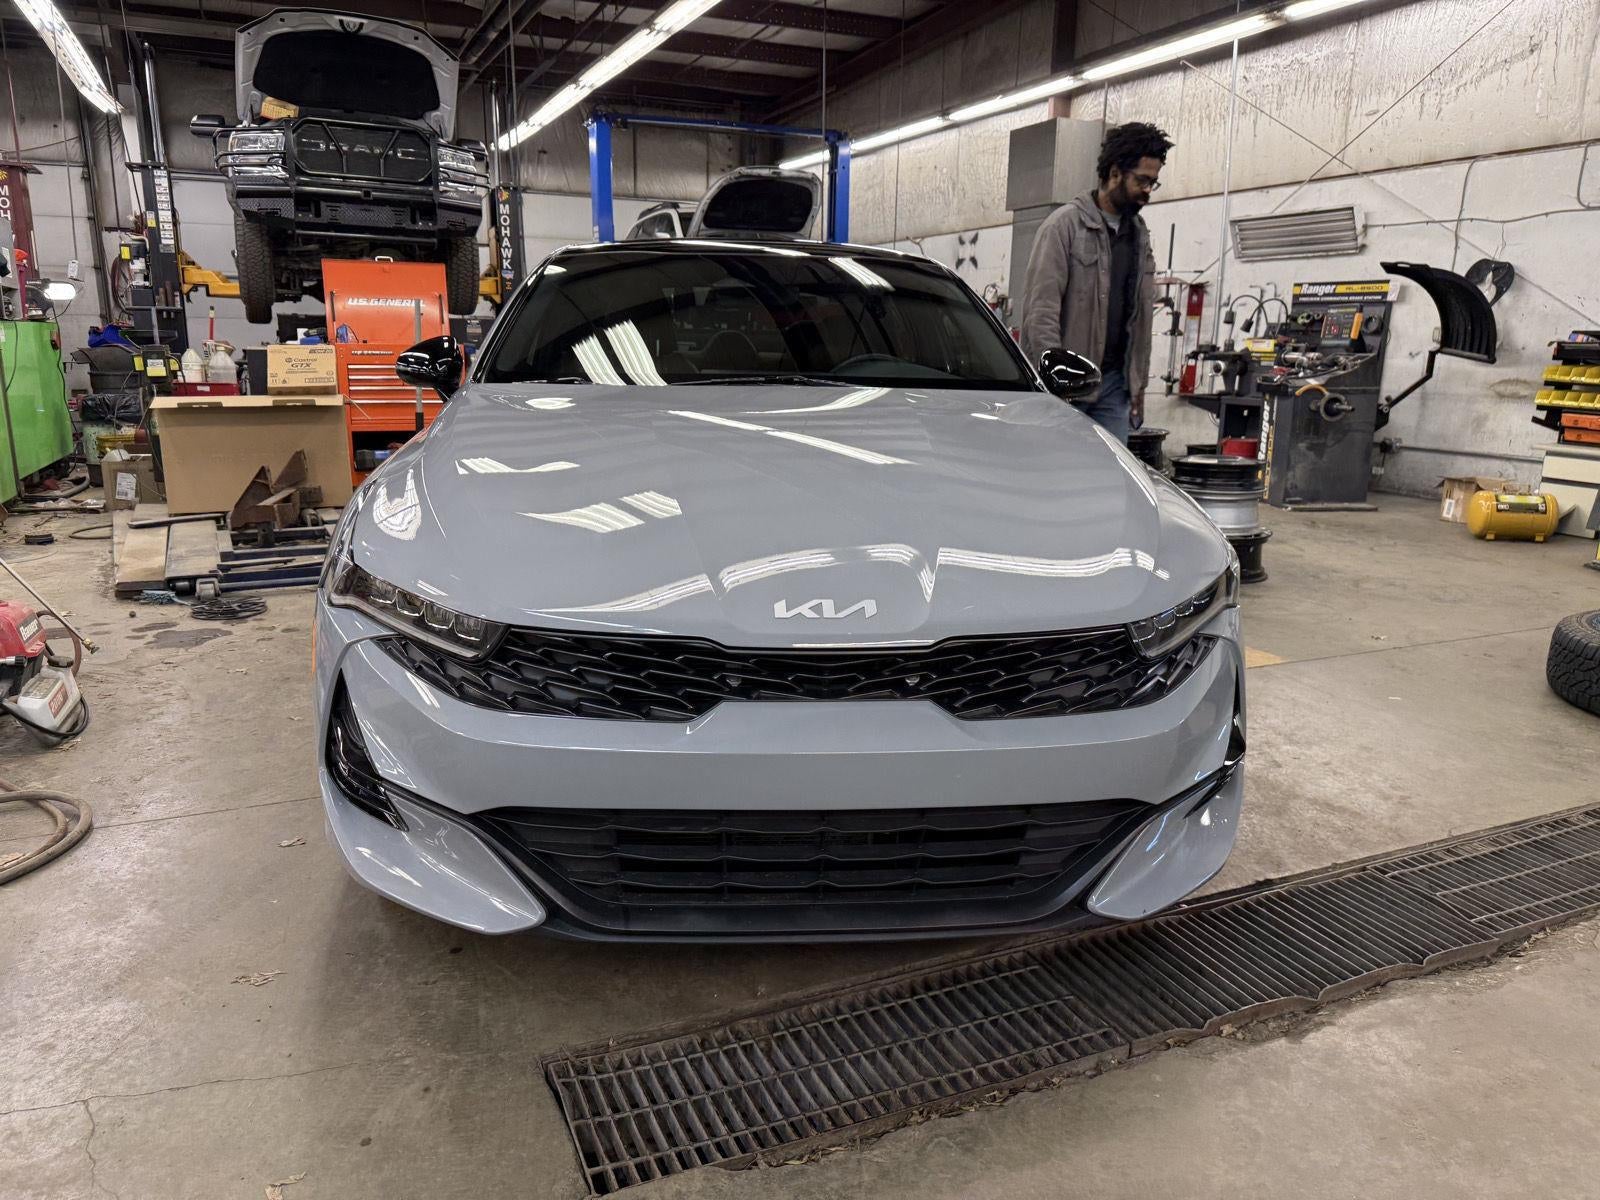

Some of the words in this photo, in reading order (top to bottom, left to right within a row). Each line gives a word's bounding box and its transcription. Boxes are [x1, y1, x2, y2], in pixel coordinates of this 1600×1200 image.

[500, 204, 512, 269] MOHAWK
[1301, 284, 1336, 295] Ranger
[1257, 401, 1271, 461] Ranger
